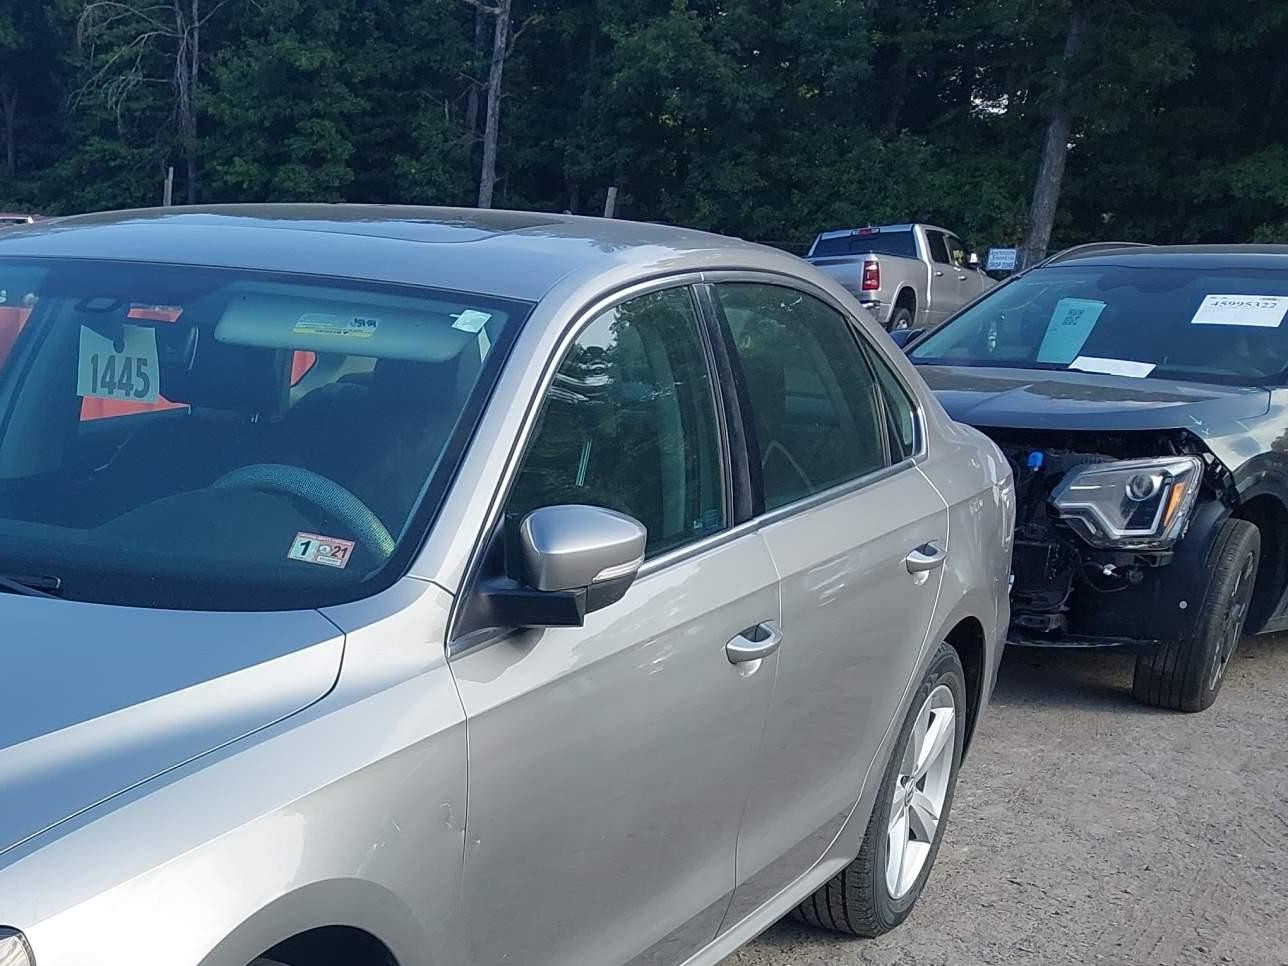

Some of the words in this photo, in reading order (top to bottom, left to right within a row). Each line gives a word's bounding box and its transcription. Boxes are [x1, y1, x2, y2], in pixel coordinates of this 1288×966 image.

[90, 353, 151, 399] 1445
[300, 540, 312, 556] 1
[330, 545, 349, 559] 21
